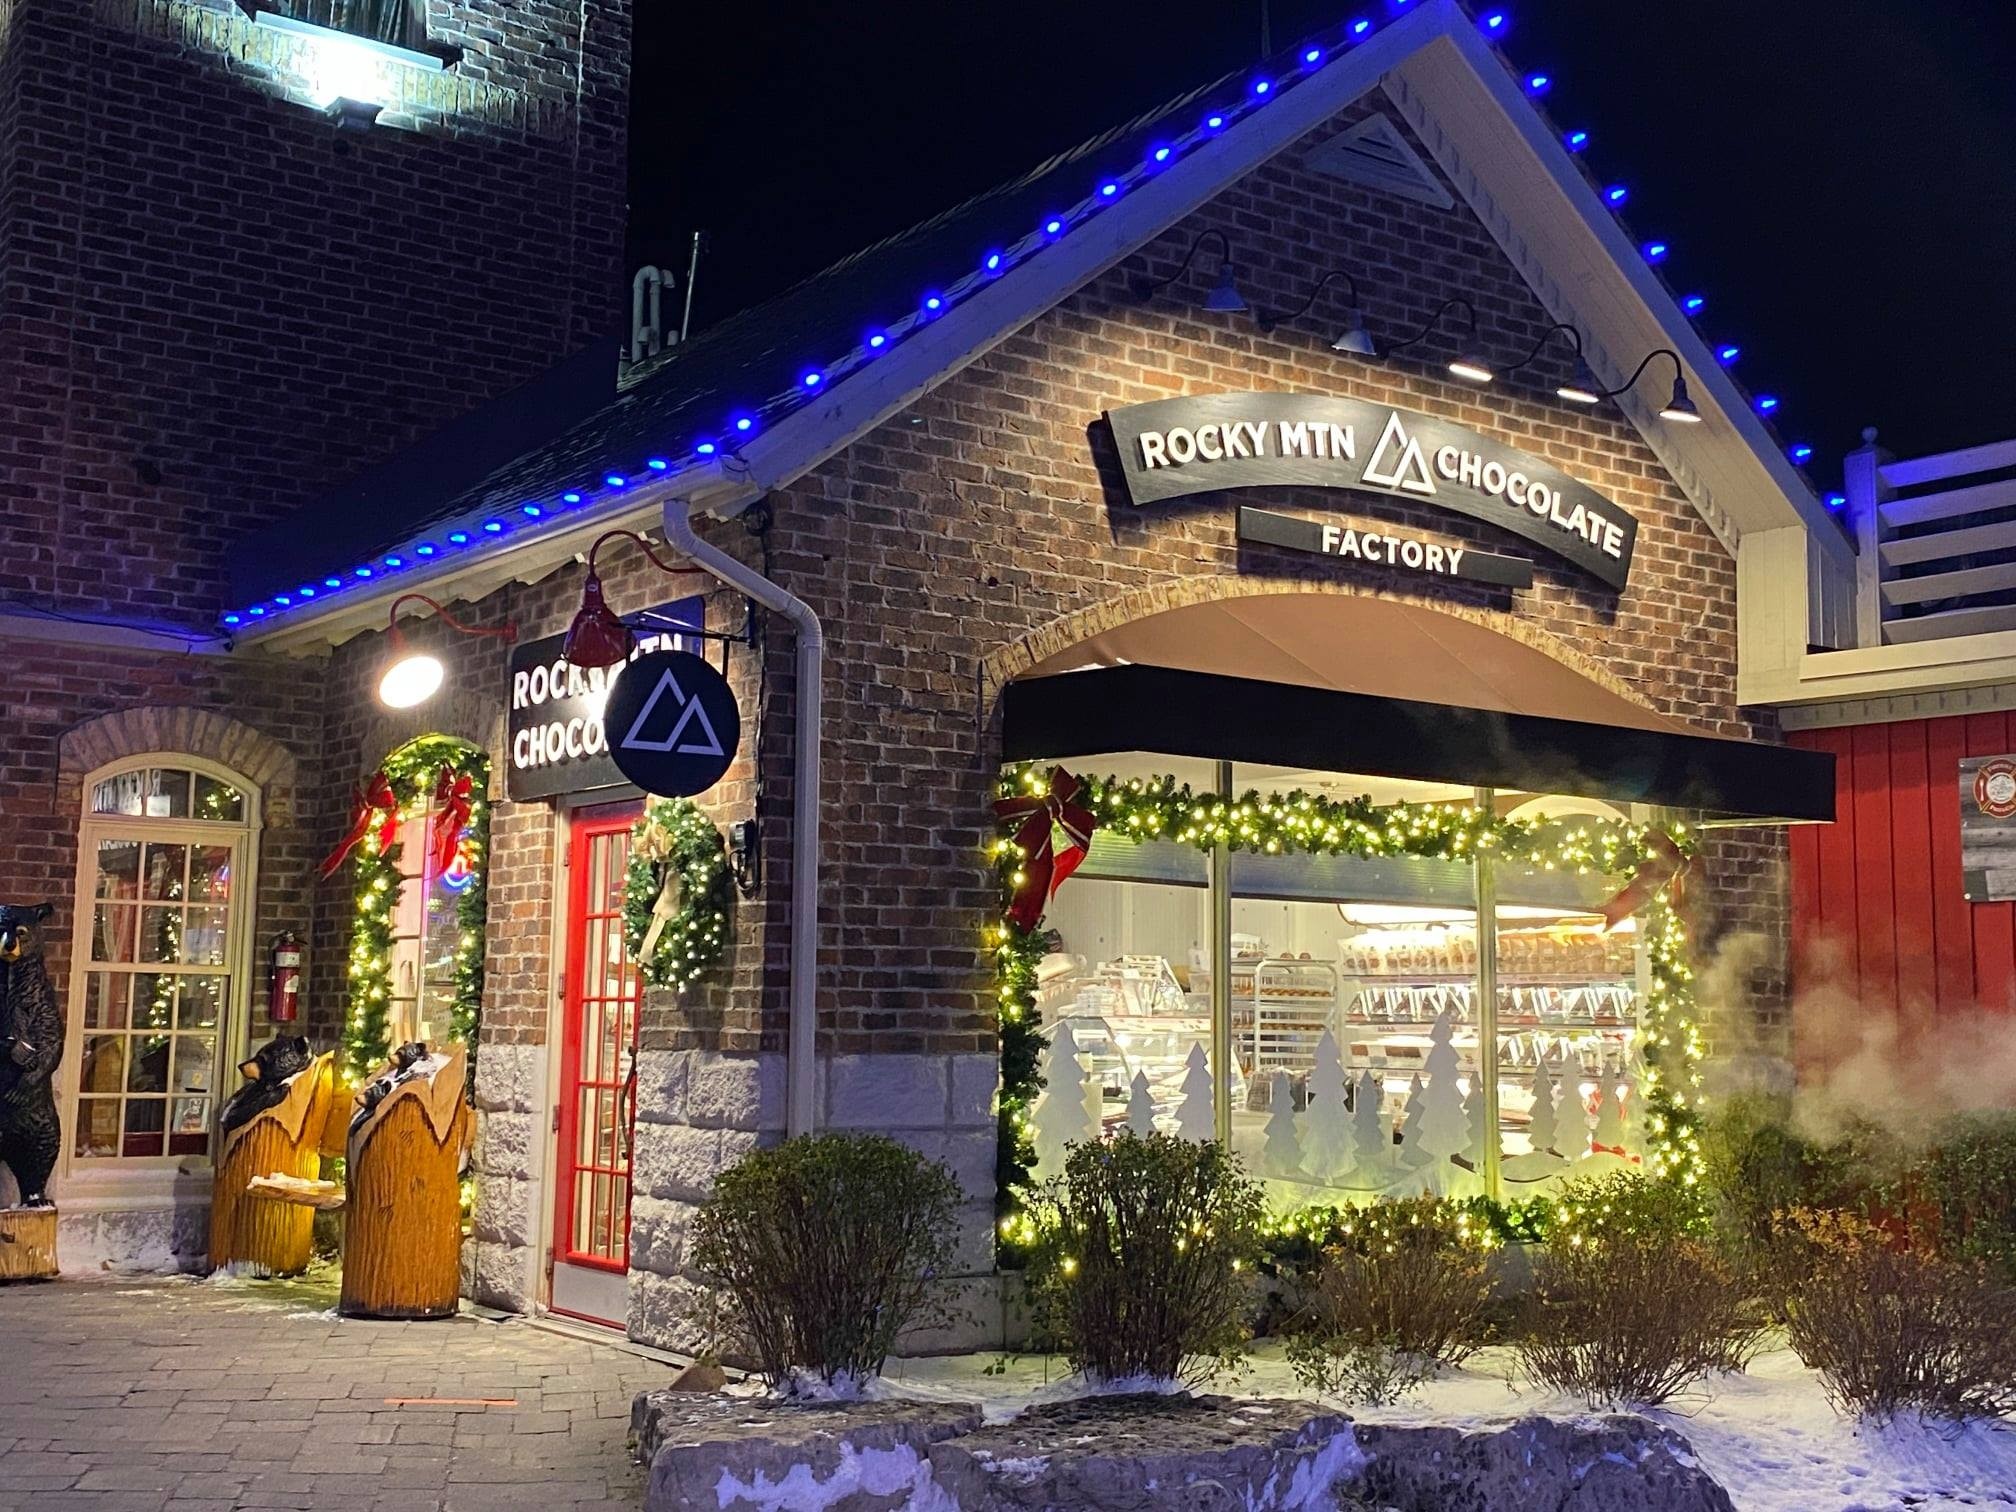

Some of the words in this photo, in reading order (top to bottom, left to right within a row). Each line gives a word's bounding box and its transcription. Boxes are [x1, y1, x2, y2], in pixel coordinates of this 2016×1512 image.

[1140, 421, 1268, 468] ROCKY
[1279, 421, 1356, 459] MTN
[1437, 445, 1624, 559] CHOCOLATE
[1322, 526, 1464, 575] FACTORY
[513, 717, 609, 769] CHOCO
